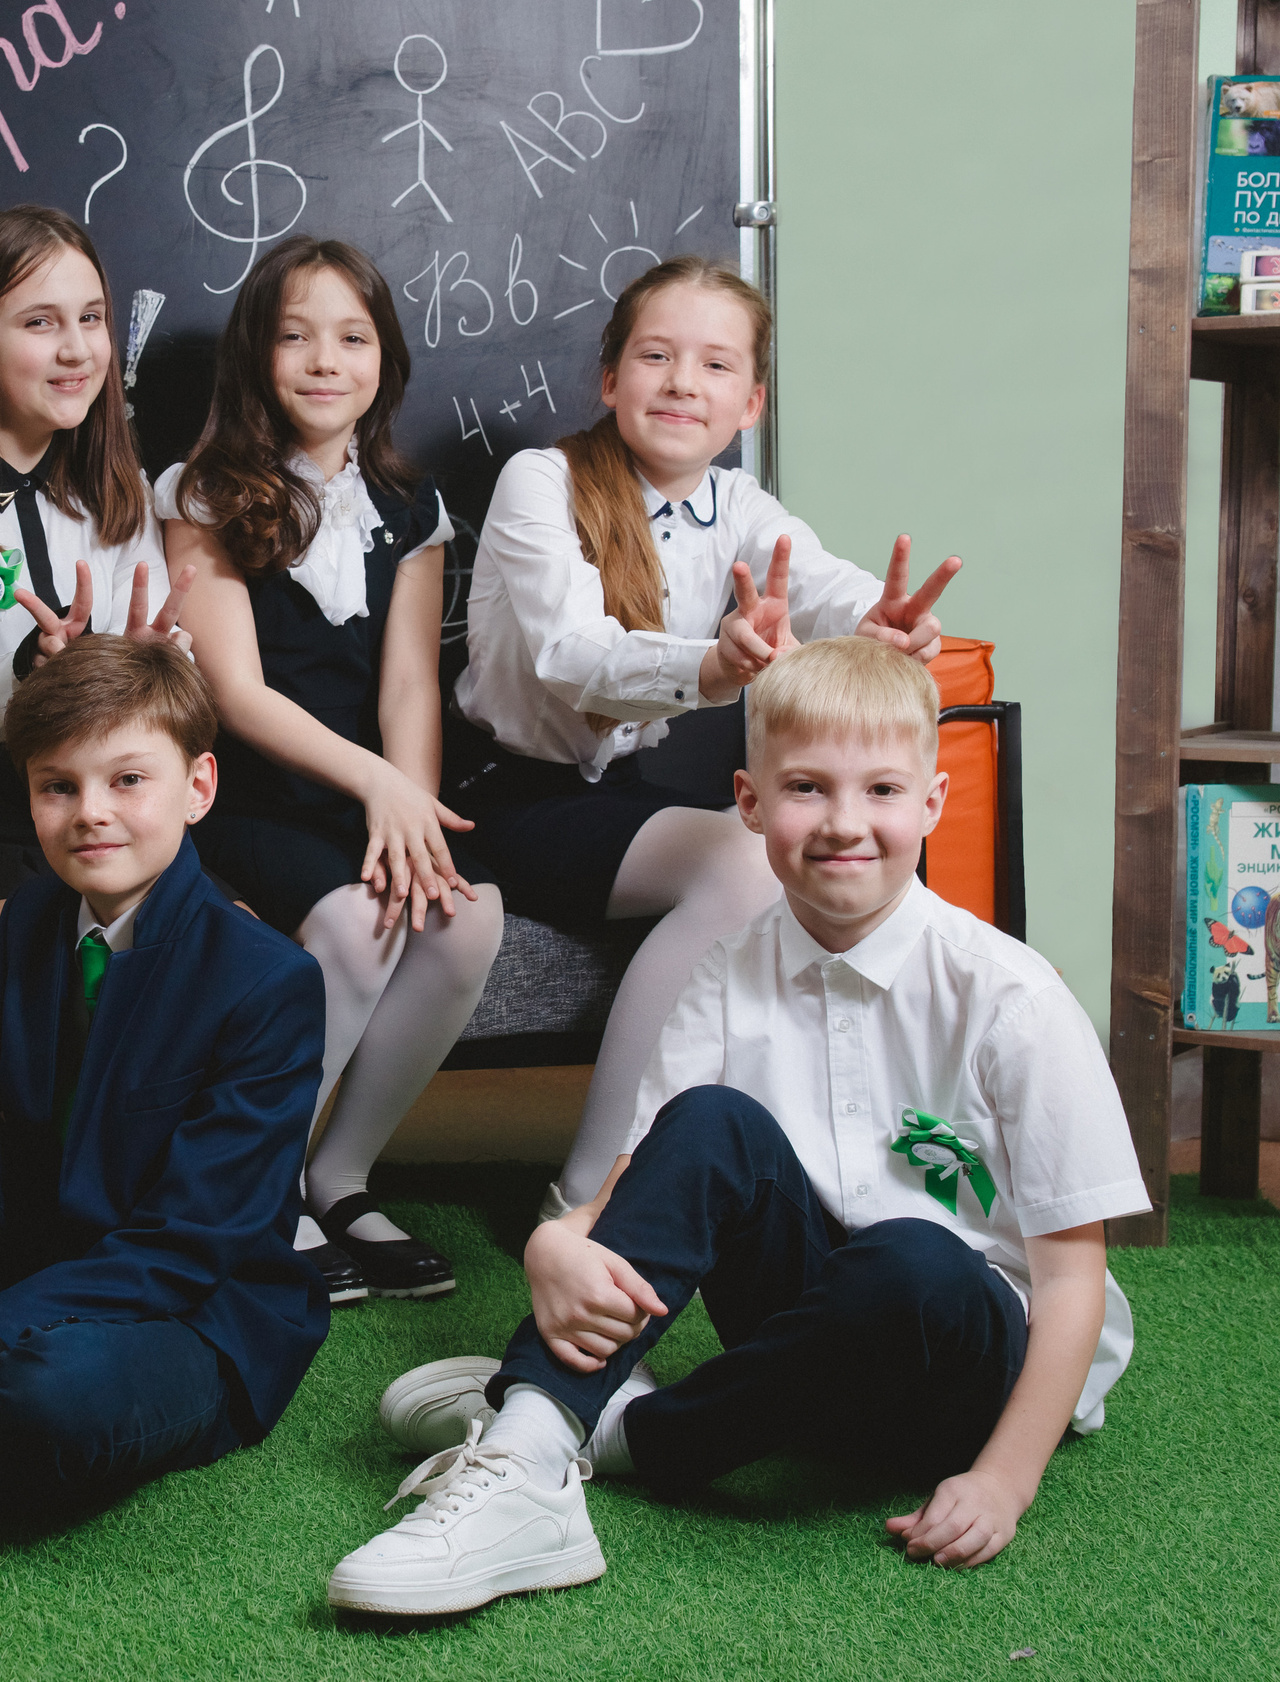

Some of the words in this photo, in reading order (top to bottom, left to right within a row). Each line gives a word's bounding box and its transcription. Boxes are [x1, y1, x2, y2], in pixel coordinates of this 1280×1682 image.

[499, 55, 646, 199] ABC
[1236, 171, 1280, 188] БОЛ
[1233, 210, 1261, 225] ПО
[1189, 855, 1199, 896] ЖИВОЙ
[1189, 899, 1198, 924] МИР
[1187, 928, 1198, 1011] ЭНЦИКЛОПЕДИЯ
